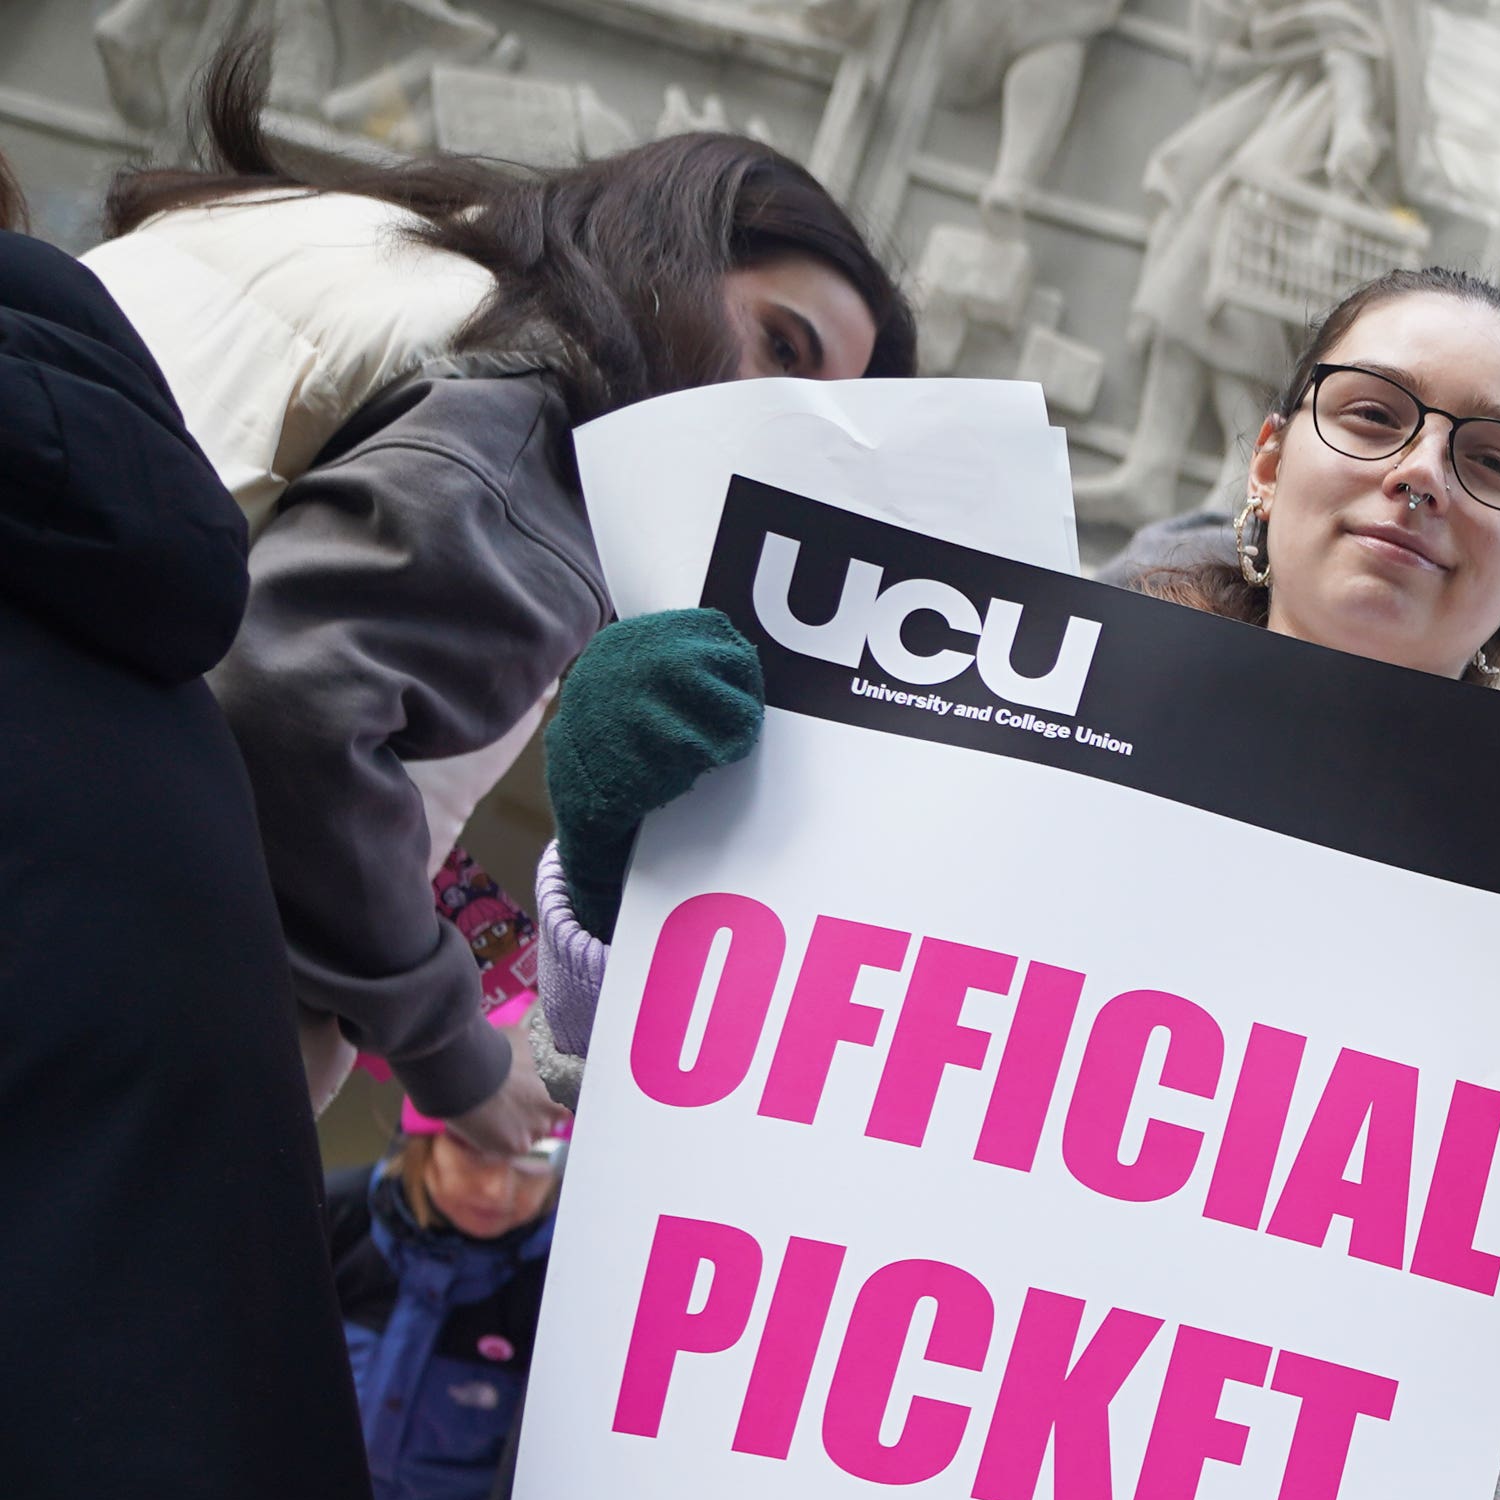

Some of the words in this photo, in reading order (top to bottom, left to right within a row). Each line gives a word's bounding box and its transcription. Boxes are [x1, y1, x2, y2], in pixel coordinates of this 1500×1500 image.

[850, 676, 955, 716] University
[953, 697, 993, 723] and
[994, 707, 1071, 740] College
[1074, 725, 1134, 756] Union
